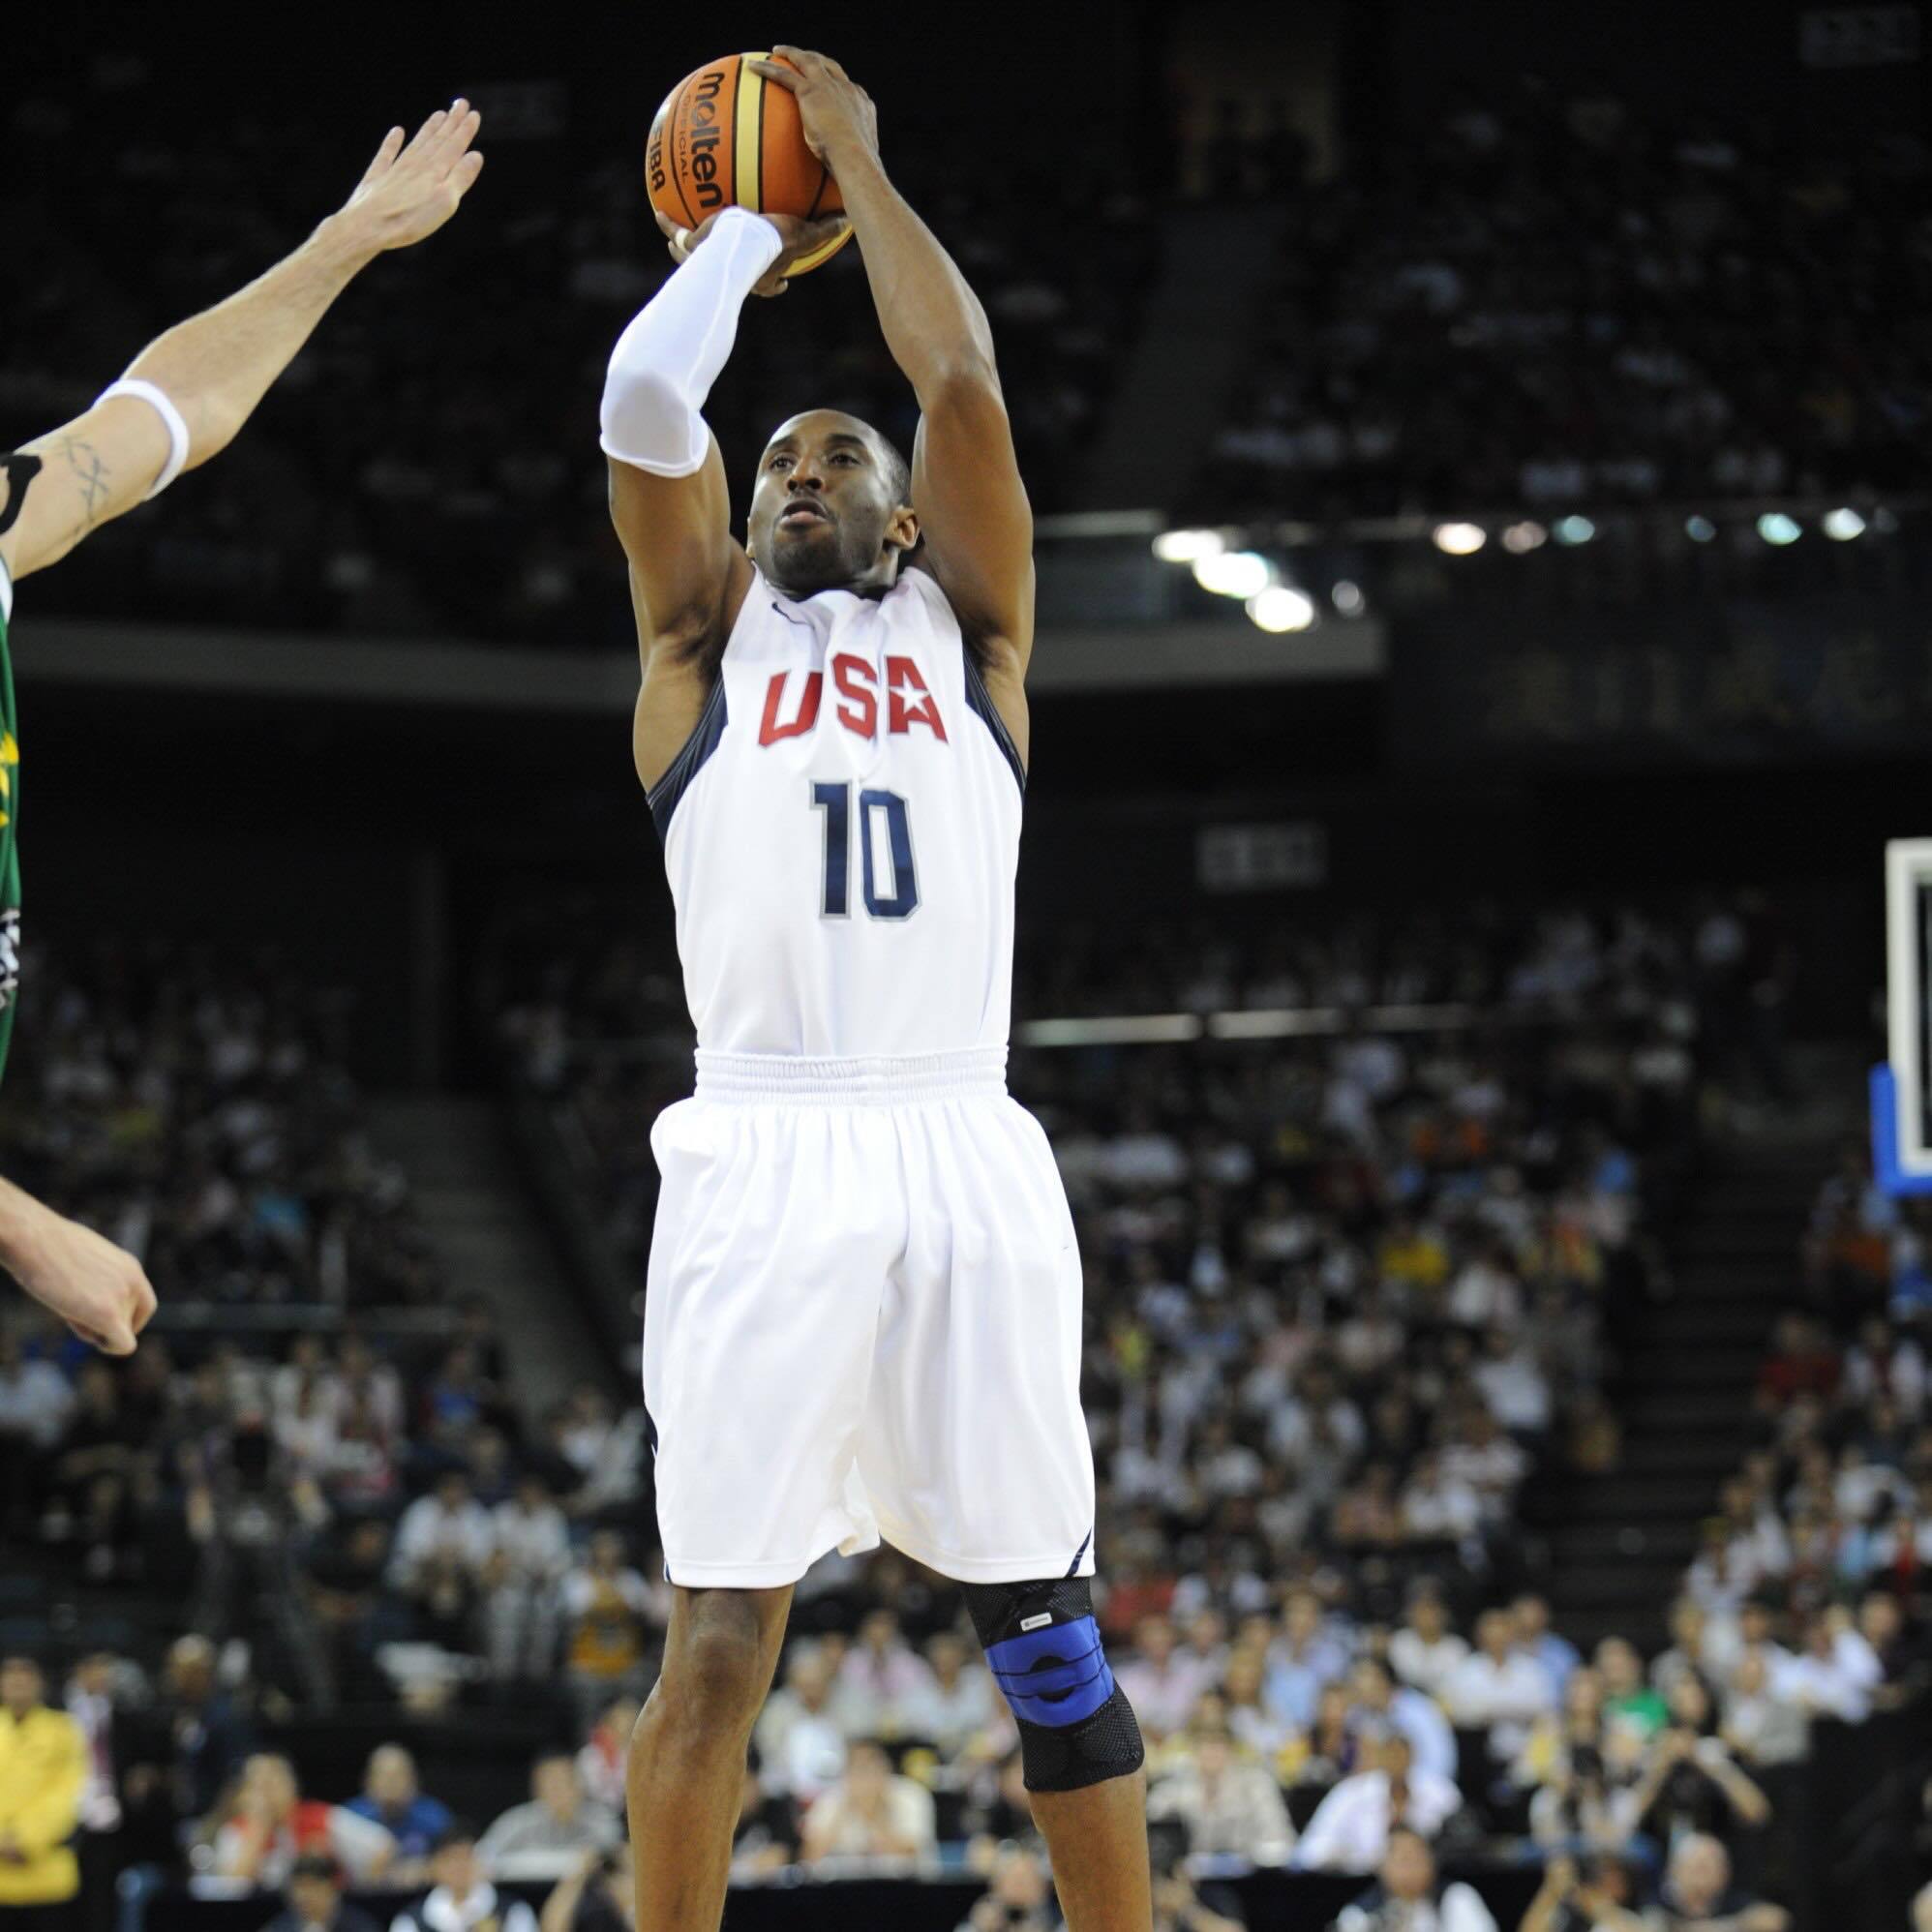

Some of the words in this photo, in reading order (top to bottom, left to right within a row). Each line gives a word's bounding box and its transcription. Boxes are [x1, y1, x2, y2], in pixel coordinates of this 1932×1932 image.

[691, 73, 724, 207] molten
[758, 652, 949, 747] USA
[809, 779, 921, 922] 10
